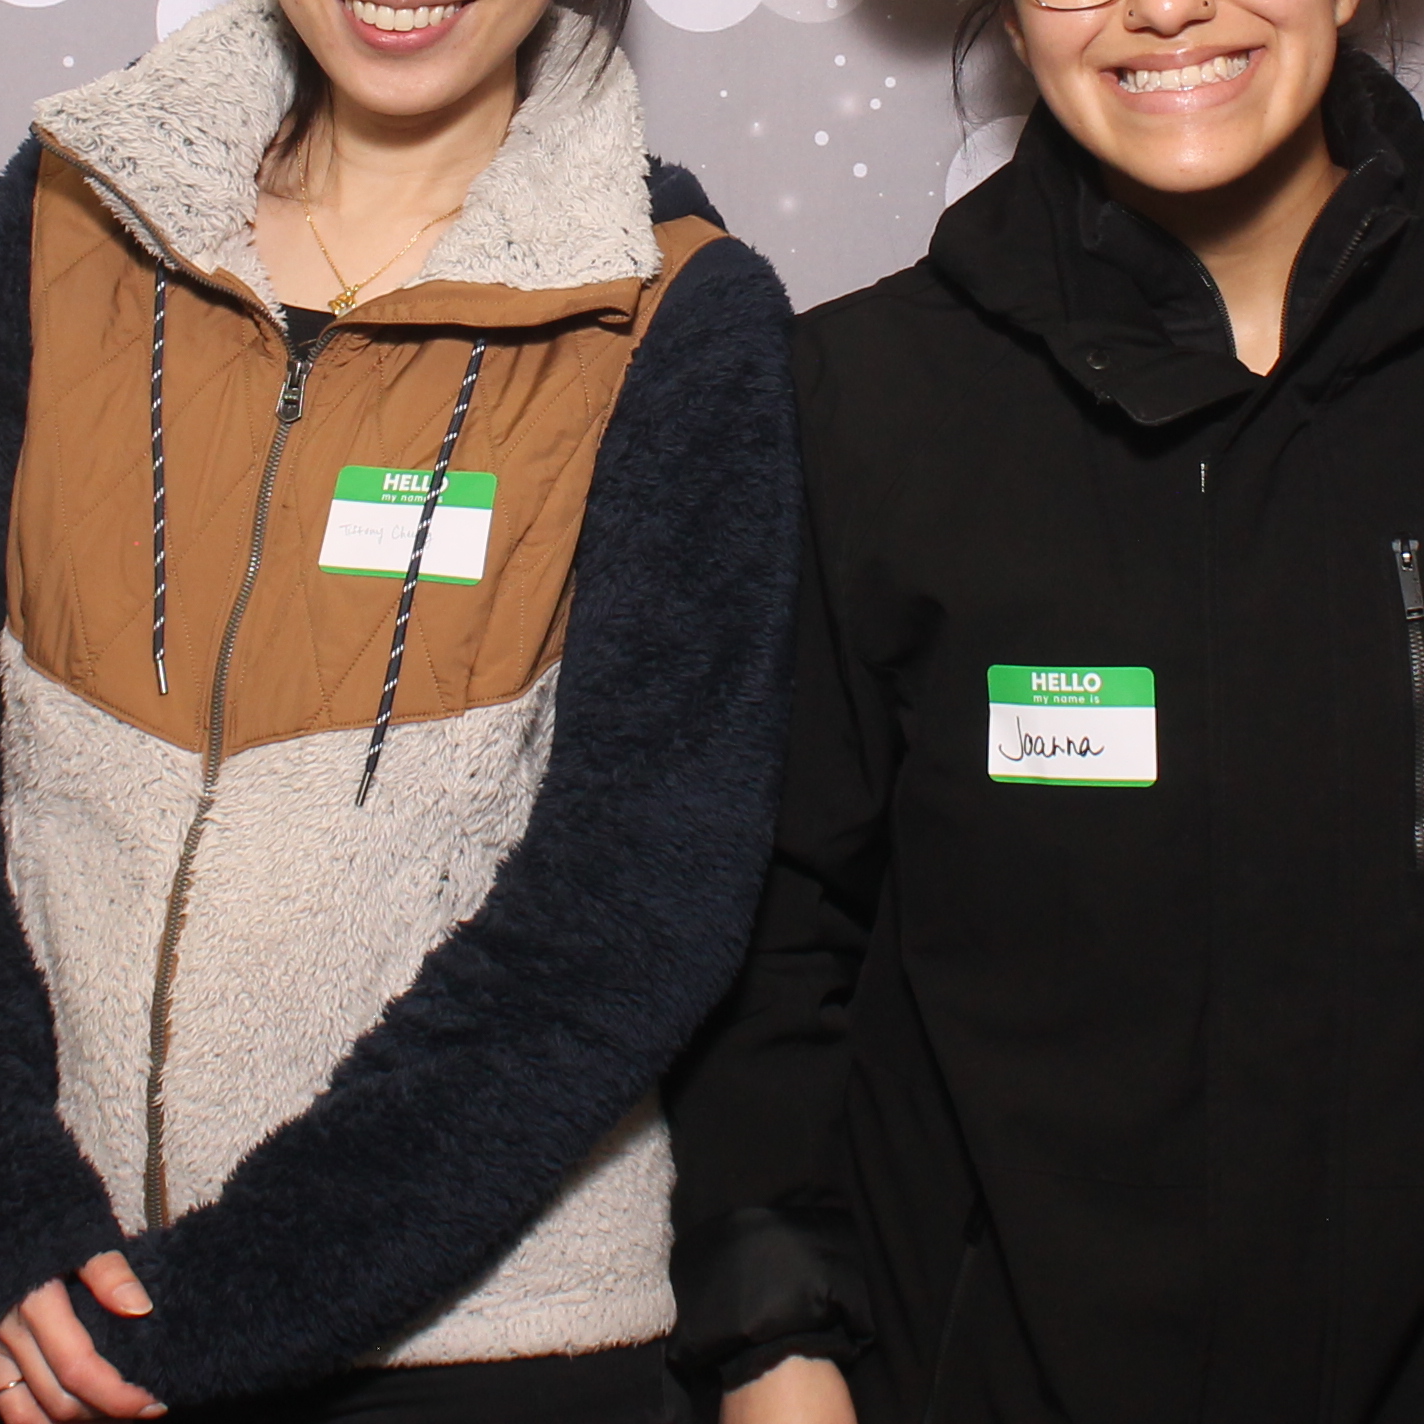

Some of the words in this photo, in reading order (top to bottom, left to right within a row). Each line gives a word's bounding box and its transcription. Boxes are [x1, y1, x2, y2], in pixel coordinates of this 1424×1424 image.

[381, 493, 397, 503] my
[400, 494, 427, 504] nam
[1031, 672, 1102, 692] HELLO
[1033, 695, 1049, 705] my
[1053, 695, 1085, 704] name
[1090, 695, 1101, 704] is
[998, 716, 1105, 761] Joanna
